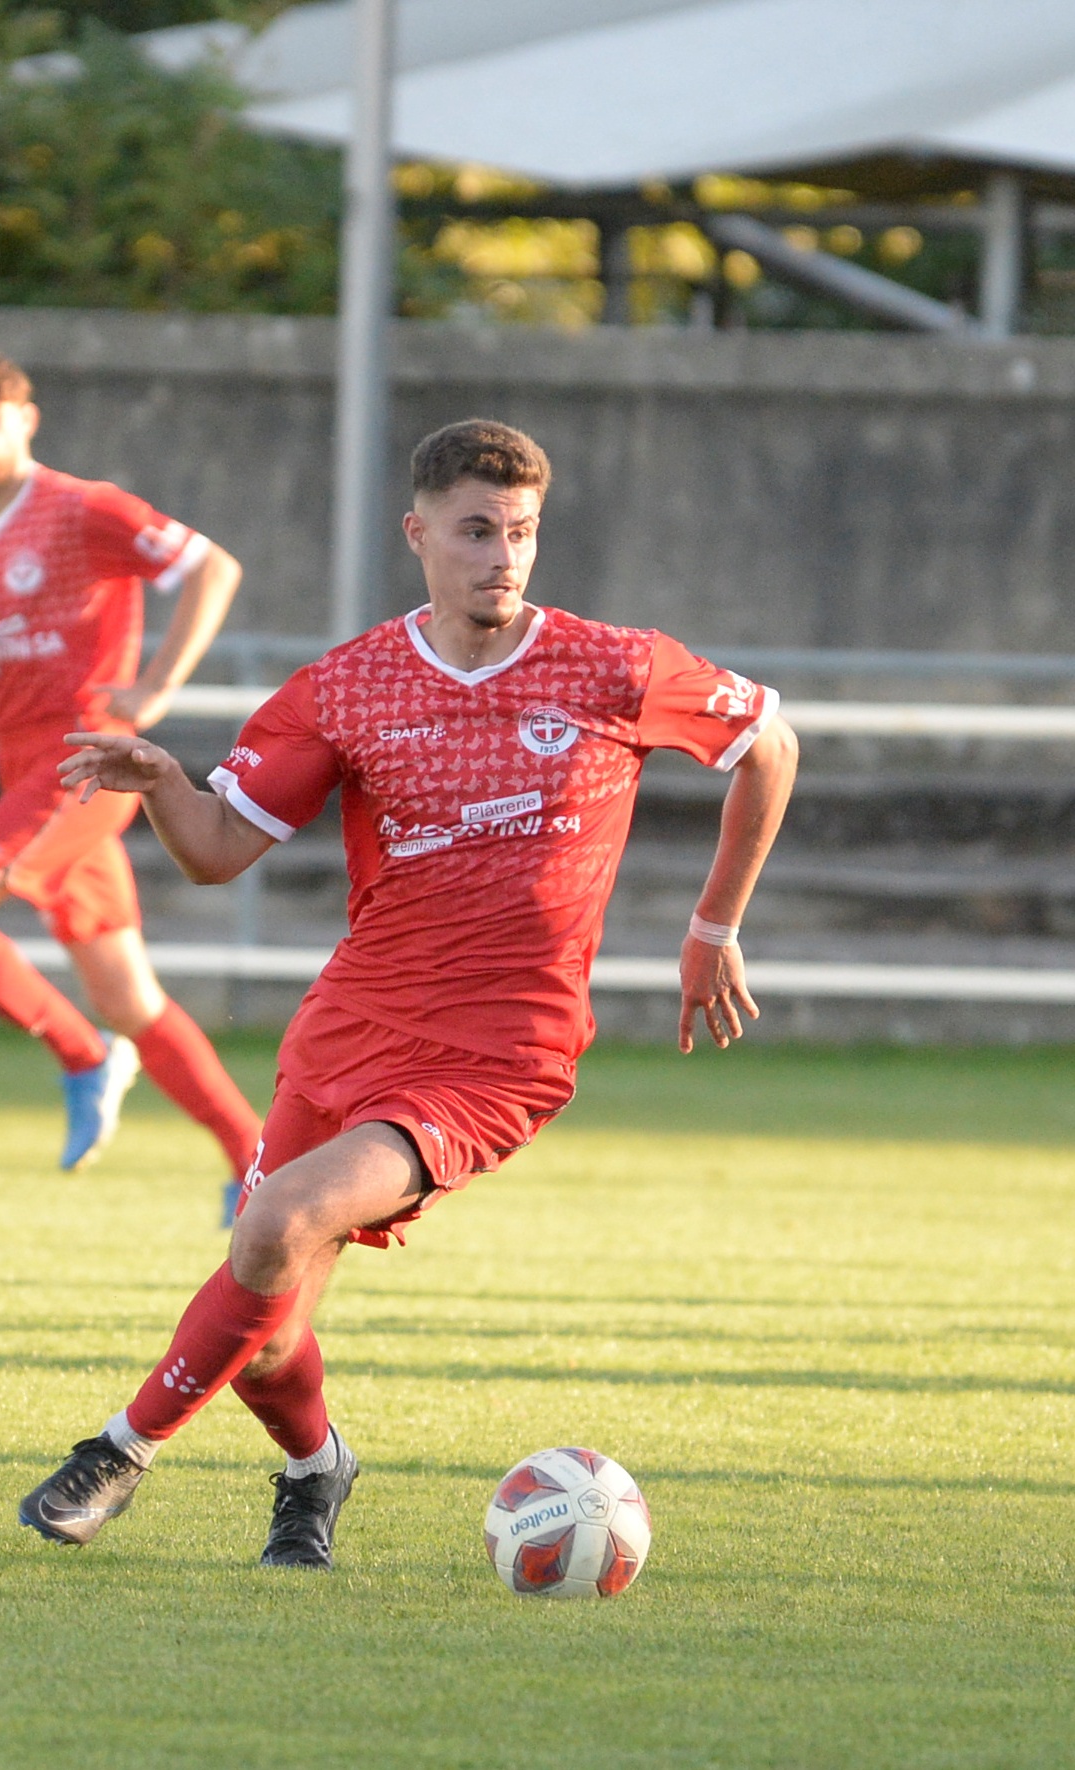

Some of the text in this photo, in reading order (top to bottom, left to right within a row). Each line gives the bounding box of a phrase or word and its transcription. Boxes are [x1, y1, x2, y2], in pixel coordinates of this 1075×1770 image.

[379, 728, 432, 741] CRAFT
[539, 744, 560, 754] 1923
[468, 796, 537, 821] Plâtrerie
[509, 1503, 568, 1537] molten
